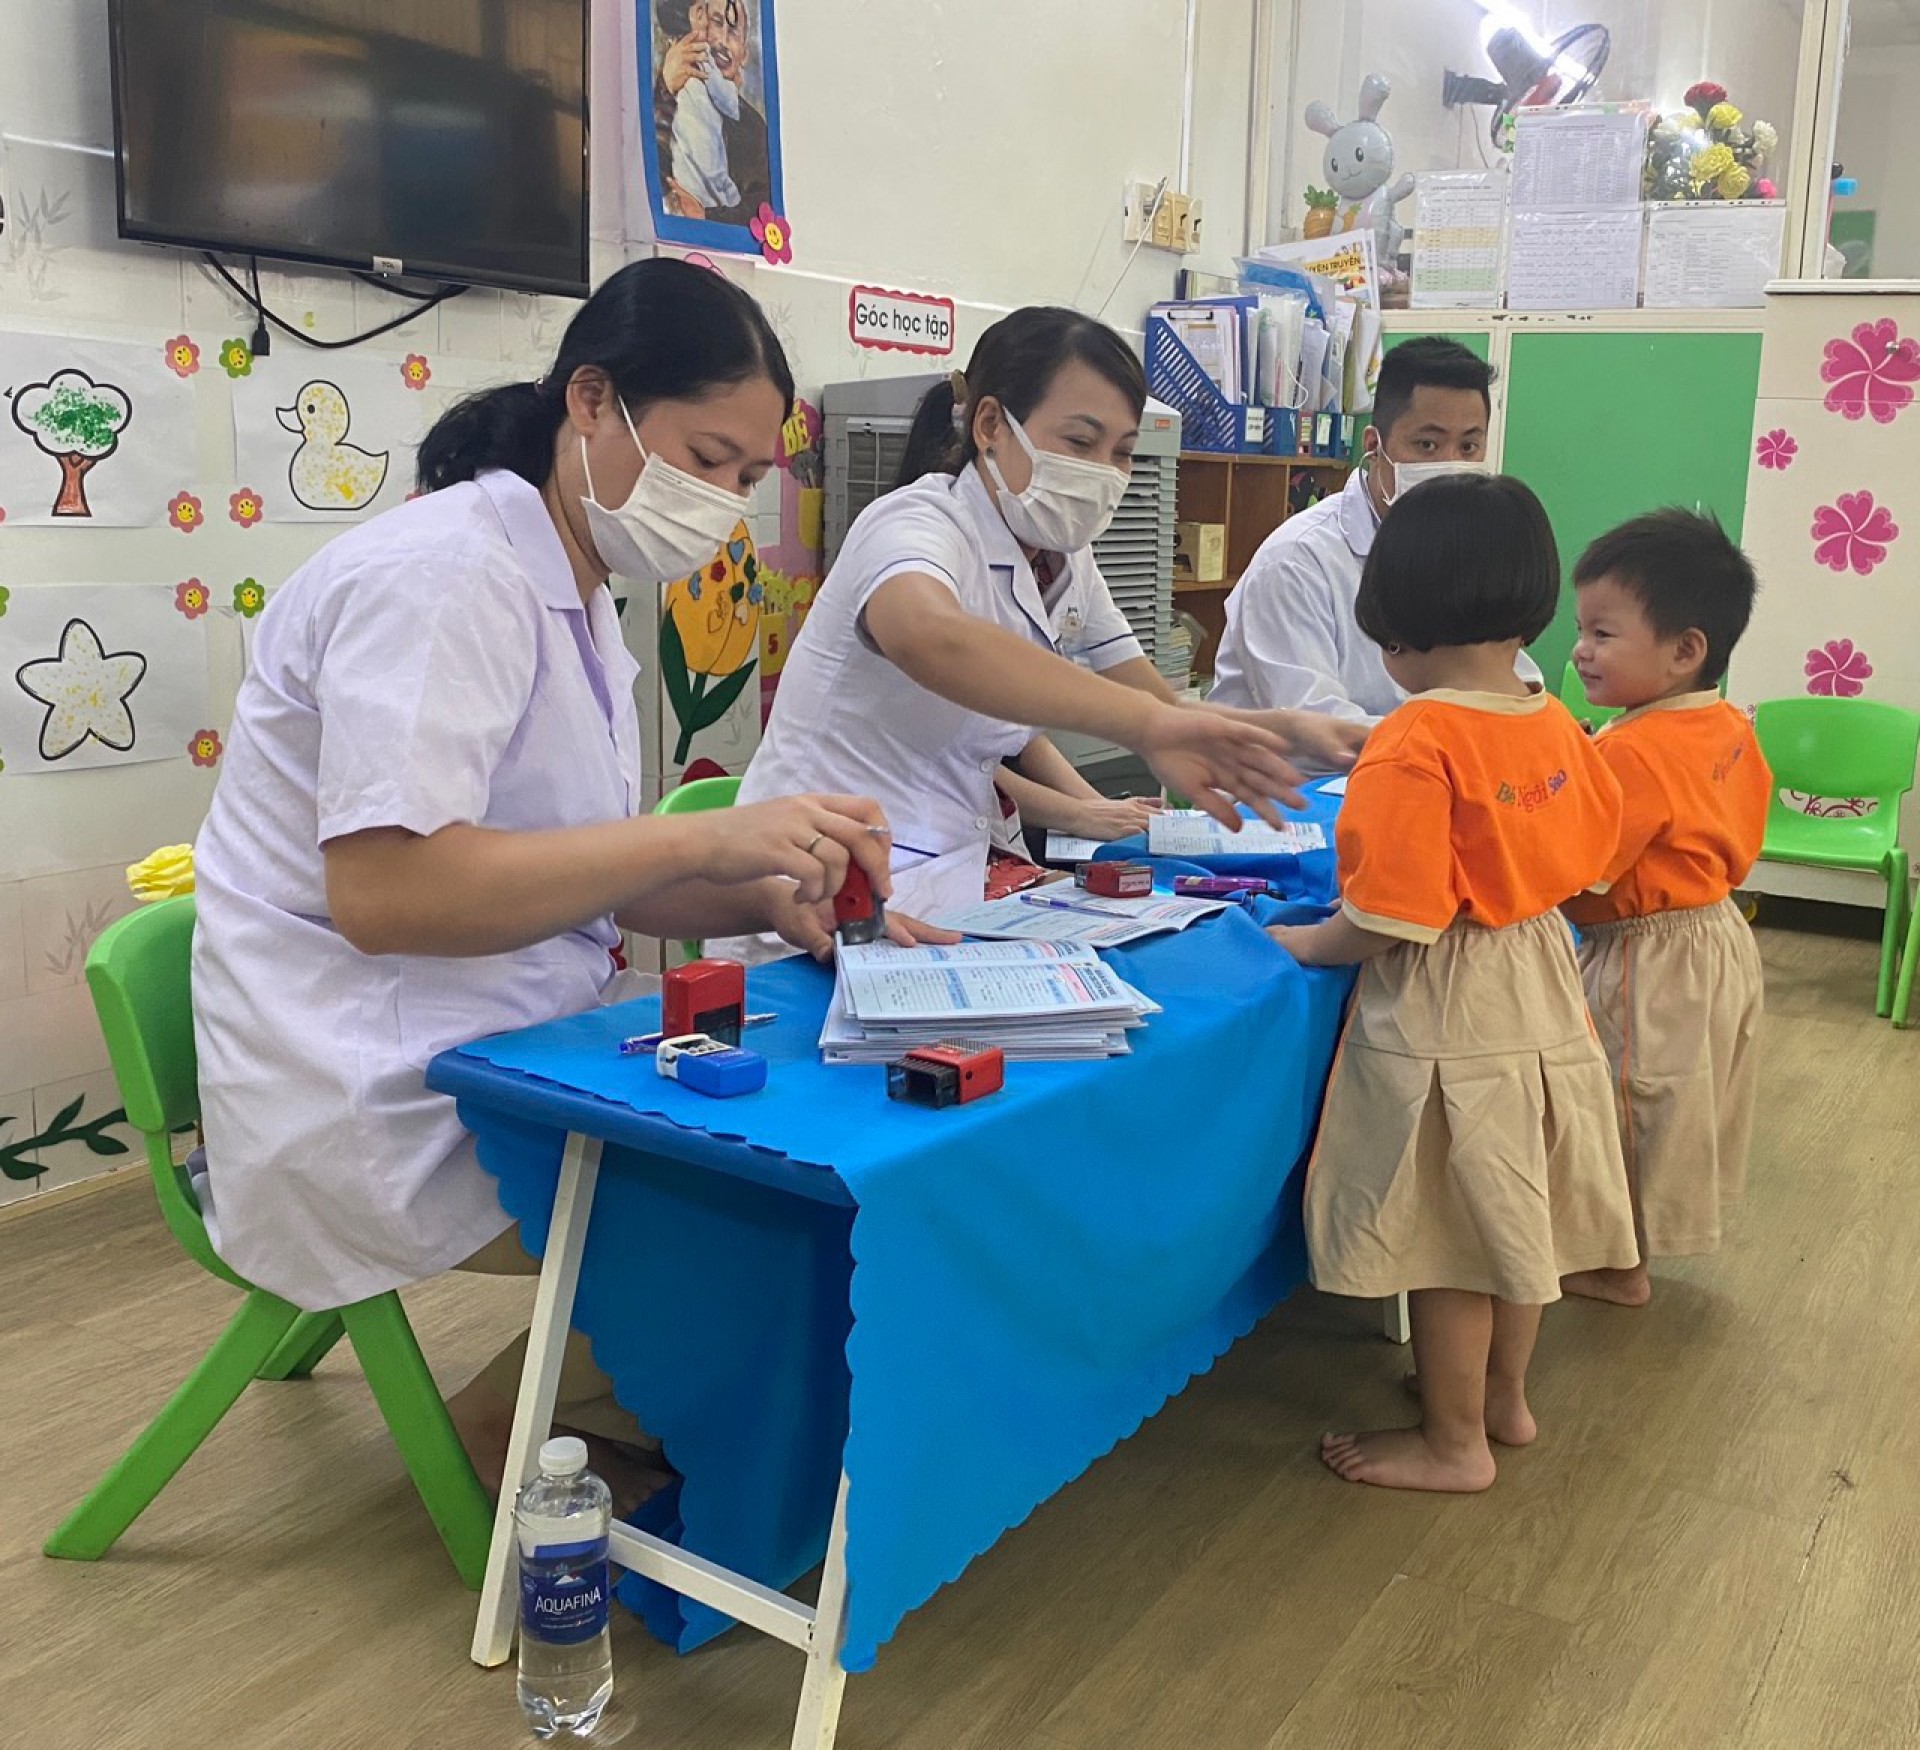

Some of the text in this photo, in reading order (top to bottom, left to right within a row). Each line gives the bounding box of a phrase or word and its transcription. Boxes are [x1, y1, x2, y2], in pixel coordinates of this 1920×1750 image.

[856, 303, 949, 341] Góc học tập
[768, 632, 778, 655] 5
[535, 1586, 601, 1615] AQUAFINA
